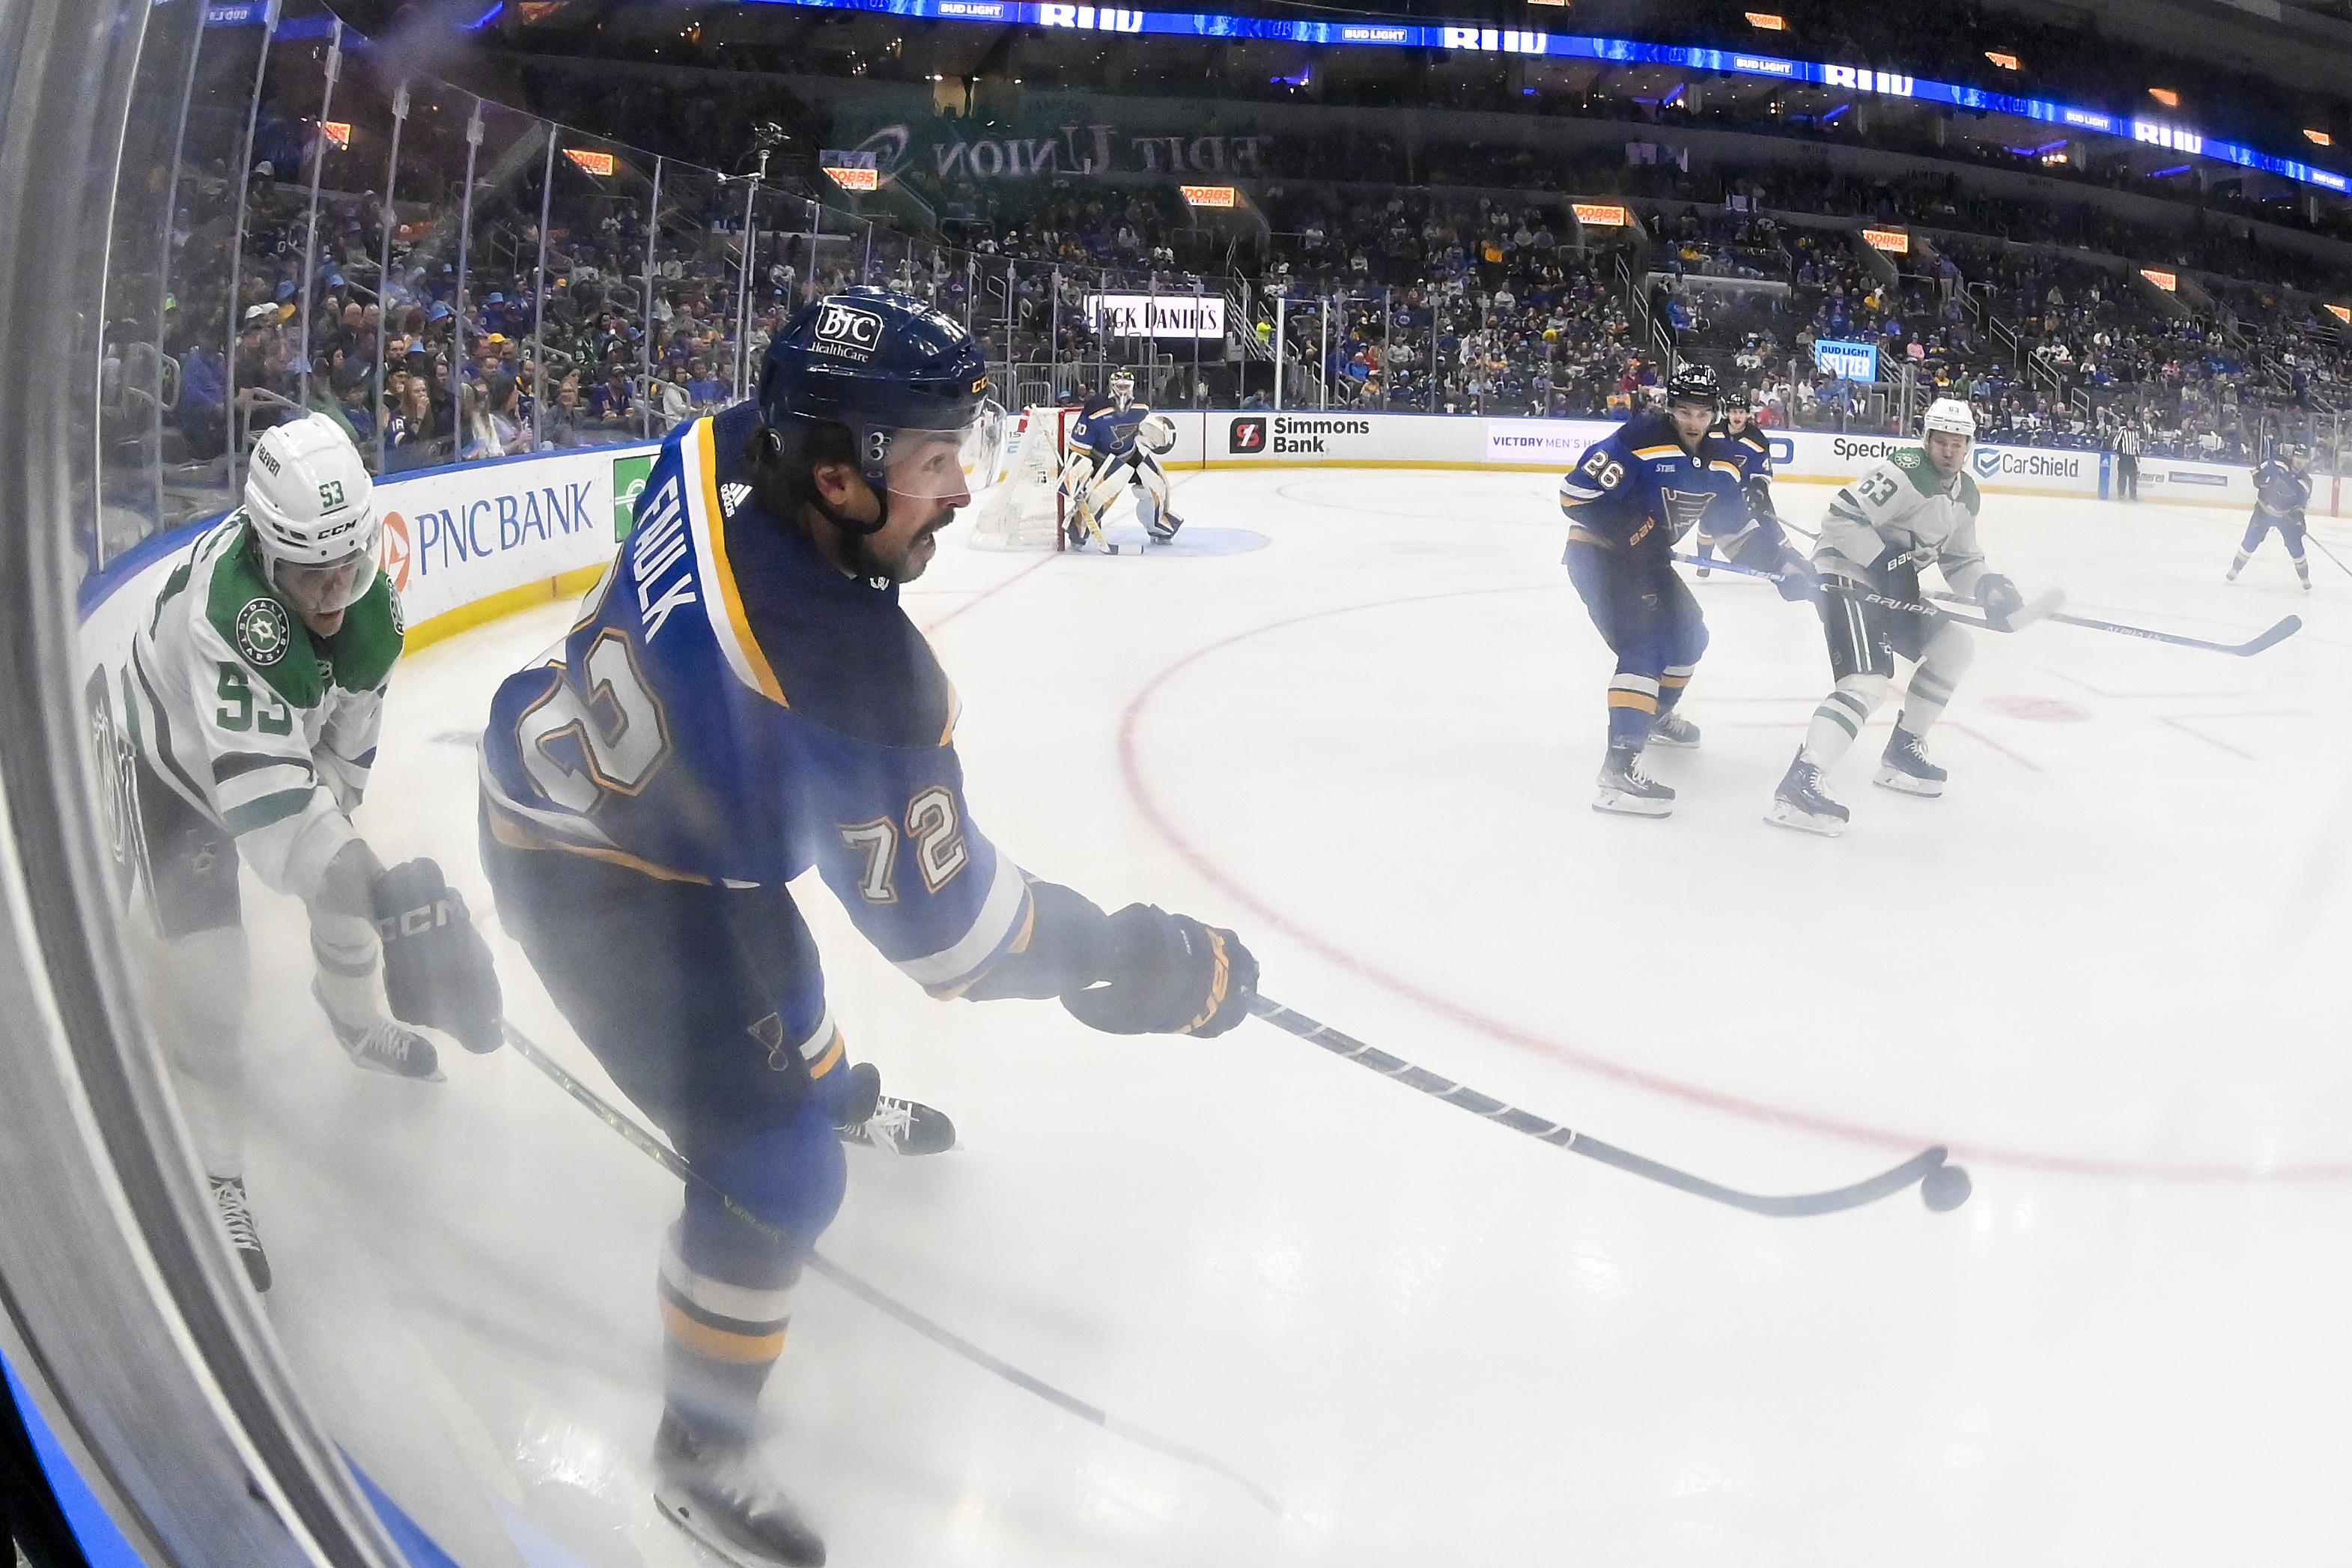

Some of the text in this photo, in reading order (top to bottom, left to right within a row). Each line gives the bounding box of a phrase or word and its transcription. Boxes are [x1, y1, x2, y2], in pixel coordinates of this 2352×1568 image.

[941, 3, 1001, 16] BUD LIGHT
[1345, 29, 1405, 40] BUD LIGHT
[1736, 58, 1790, 73] BUD LIGHT
[2066, 112, 2109, 130] BUD LIGHT
[1185, 188, 1232, 200] DOBBS
[1575, 207, 1622, 219] DOBBS
[820, 309, 876, 342] BJC
[812, 341, 869, 363] HealthCare
[1821, 345, 1870, 357] BUD LIGHT
[1274, 417, 1370, 434] Simmons
[1274, 435, 1325, 453] Bank
[1492, 437, 1543, 447] VICTORY
[1546, 438, 1580, 449] MEN'S
[1581, 449, 1626, 490] 26
[2002, 453, 2079, 478] CarShield
[318, 480, 345, 508] 53
[317, 519, 357, 540] CCM
[633, 475, 697, 645] FAULK
[249, 600, 287, 646] DALLAS
[239, 622, 274, 661] STARS
[834, 785, 970, 905] 72
